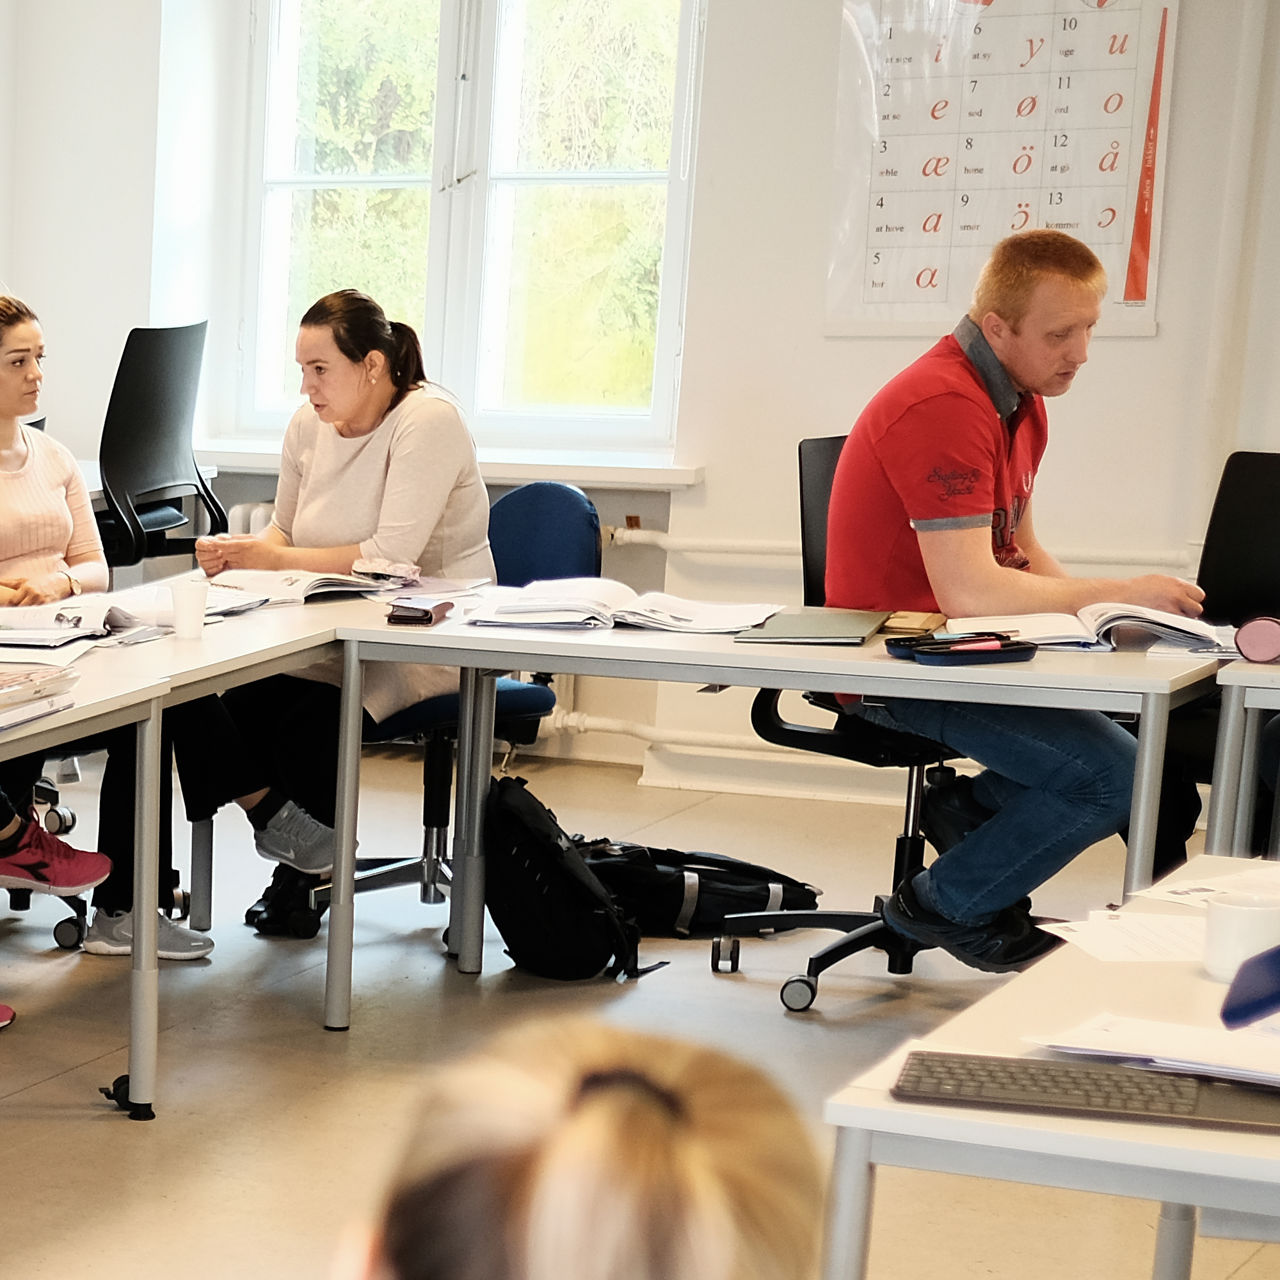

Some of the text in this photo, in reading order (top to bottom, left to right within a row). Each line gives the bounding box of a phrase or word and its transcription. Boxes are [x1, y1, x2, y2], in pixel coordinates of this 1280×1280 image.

[973, 22, 982, 35] 6
[1062, 17, 1078, 31] 10
[1108, 34, 1129, 55] u
[1020, 38, 1045, 68] y
[970, 80, 978, 93] 7
[1057, 76, 1071, 89] 11
[883, 84, 891, 97] 2
[930, 99, 949, 120] e
[1016, 95, 1038, 118] ø
[1104, 93, 1124, 114] o
[879, 140, 888, 154] 3
[965, 137, 973, 150] 8
[1053, 134, 1069, 147] 12
[1012, 146, 1035, 175] ö
[1098, 140, 1120, 172] å
[922, 156, 950, 177] æ
[876, 196, 884, 208] 4
[961, 194, 969, 207] 9
[1048, 192, 1063, 205] 13
[922, 212, 943, 233] a
[872, 252, 881, 265] 5
